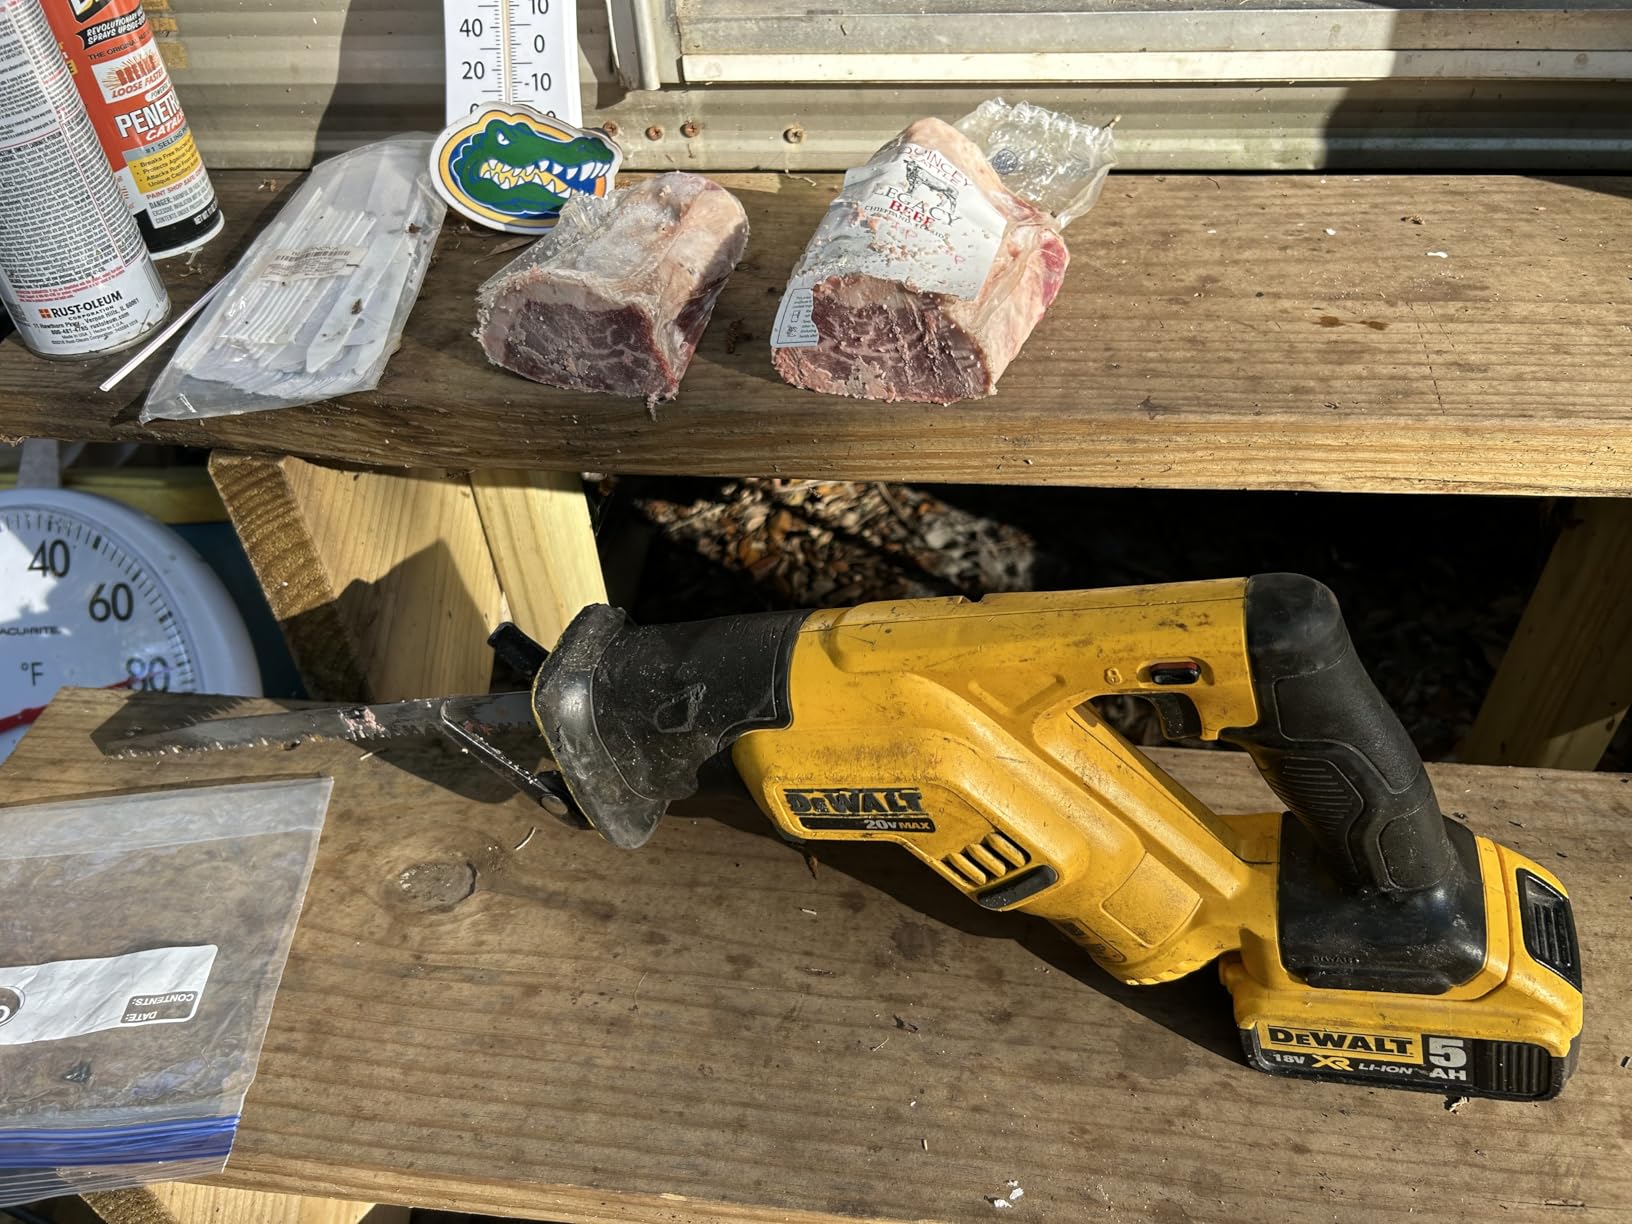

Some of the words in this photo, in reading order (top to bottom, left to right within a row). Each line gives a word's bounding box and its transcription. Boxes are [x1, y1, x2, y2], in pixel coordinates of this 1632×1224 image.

[529, 0, 549, 14] 10
[459, 18, 483, 37] 40
[87, 29, 116, 45] SPRAYS
[534, 34, 545, 53] 0
[88, 52, 105, 60] THE
[462, 61, 485, 80] 20
[112, 81, 142, 98] LOOSE
[524, 72, 551, 91] -10
[157, 131, 183, 149] SELLING
[140, 156, 162, 168] Breaks
[162, 151, 175, 159] Free
[143, 163, 168, 174] Protects
[146, 170, 169, 181] Attacks
[148, 177, 171, 188] Unique
[146, 190, 166, 200] PAINT
[167, 183, 182, 194] SHOP
[873, 184, 962, 226] LEGACY
[889, 199, 935, 226] BEEF
[50, 290, 123, 318] RUST-OLEUM
[68, 305, 114, 320] CORPORATION
[84, 314, 104, 323] Vernon
[90, 312, 129, 329] rustoleum.com
[28, 539, 71, 578] 40
[88, 583, 134, 622] 60
[125, 656, 170, 692] 80
[898, 821, 931, 831] MAX
[131, 993, 194, 1006] CONTENTS:
[125, 1010, 157, 1022] DATE:
[1428, 1037, 1467, 1068] 5
[1273, 1053, 1305, 1065] 18V
[1311, 1054, 1354, 1071] XR
[1358, 1063, 1413, 1075] LI-ION
[1429, 1068, 1467, 1081] AH
